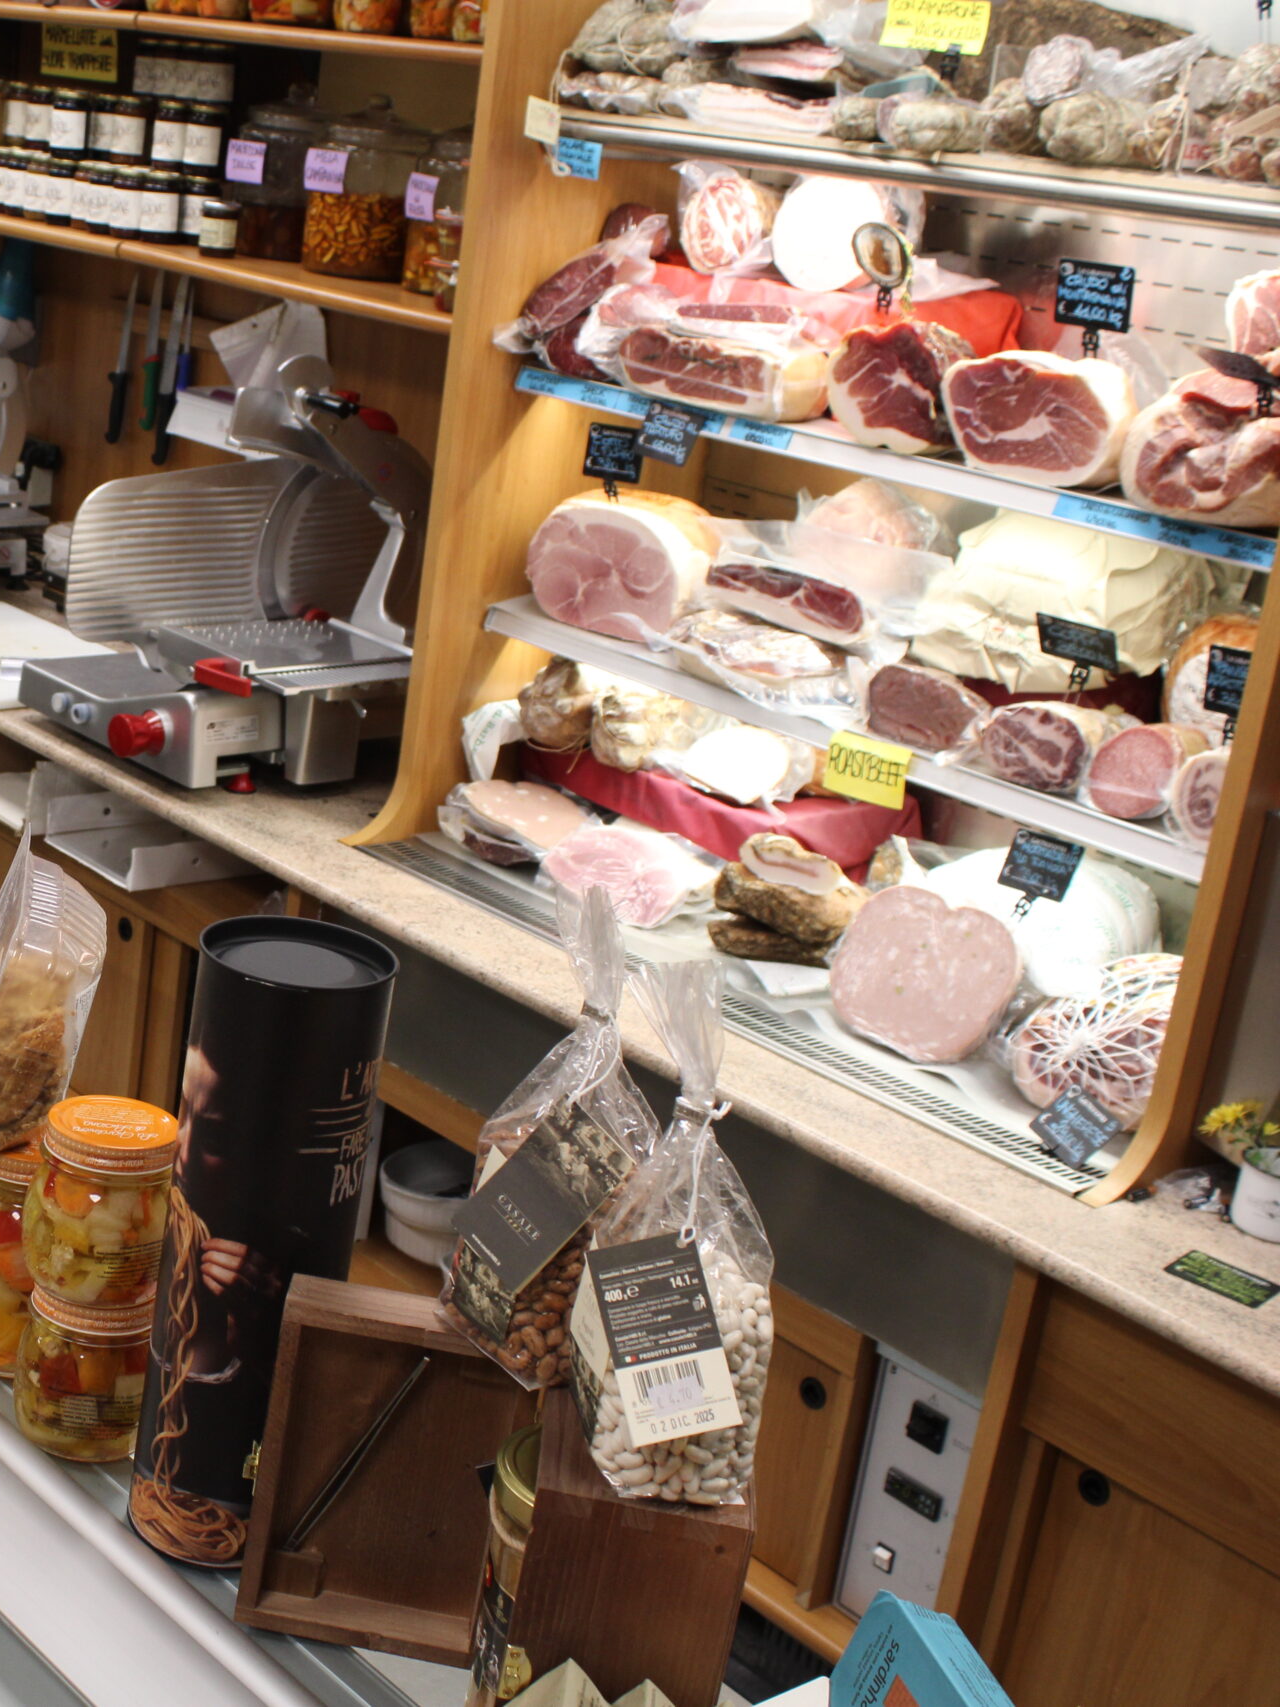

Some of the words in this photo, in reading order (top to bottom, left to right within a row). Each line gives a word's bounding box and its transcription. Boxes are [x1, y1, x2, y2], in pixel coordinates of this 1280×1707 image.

[498, 1193, 541, 1241] CASALE
[669, 1274, 691, 1289] 14.1
[678, 1341, 698, 1353] ITALIA
[695, 1408, 716, 1426] 2025
